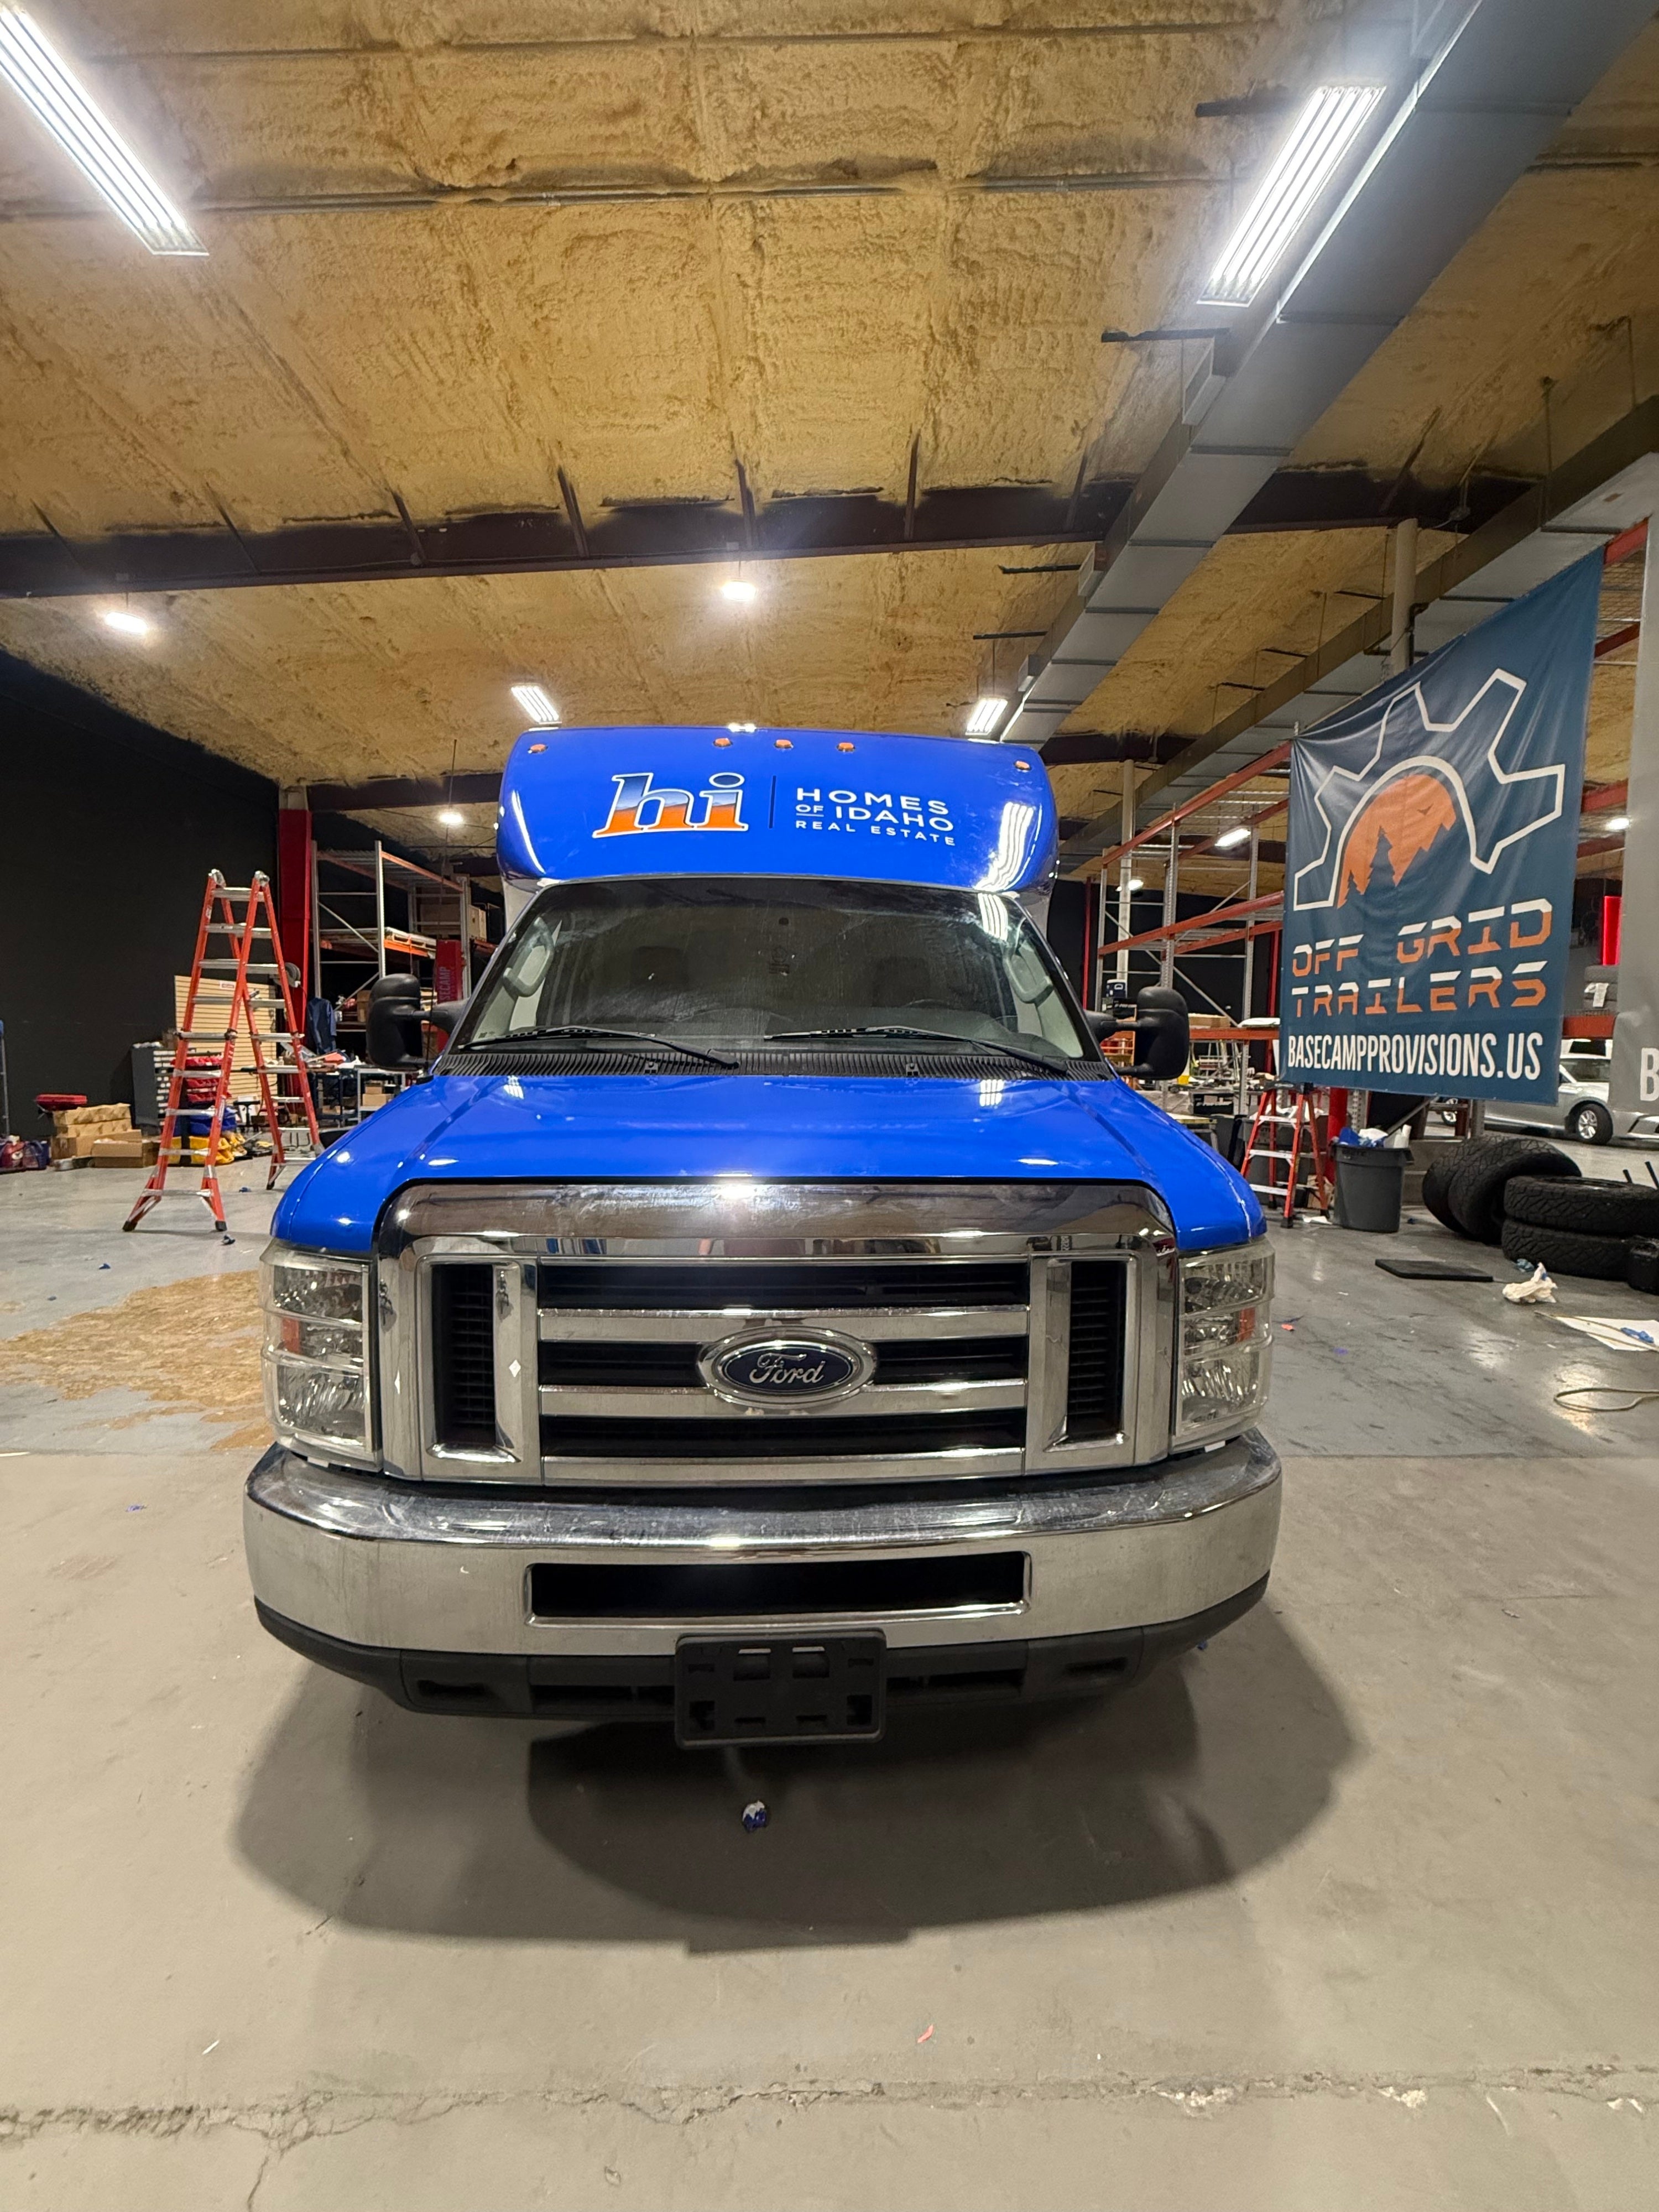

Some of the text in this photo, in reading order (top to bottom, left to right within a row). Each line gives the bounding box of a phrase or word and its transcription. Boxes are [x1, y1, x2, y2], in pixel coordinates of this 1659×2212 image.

[592, 771, 749, 838] hi
[795, 804, 954, 832] OF IDAHO
[796, 787, 949, 815] HOMES
[796, 820, 956, 846] REAL ESTATE
[1292, 898, 1553, 978] OFF GRID
[439, 966, 451, 1001] SECAMP
[1291, 960, 1548, 1018] TRAILERS
[1287, 1032, 1543, 1081] BASECAMPPROVISIONS.US
[749, 1353, 826, 1383] Ford
